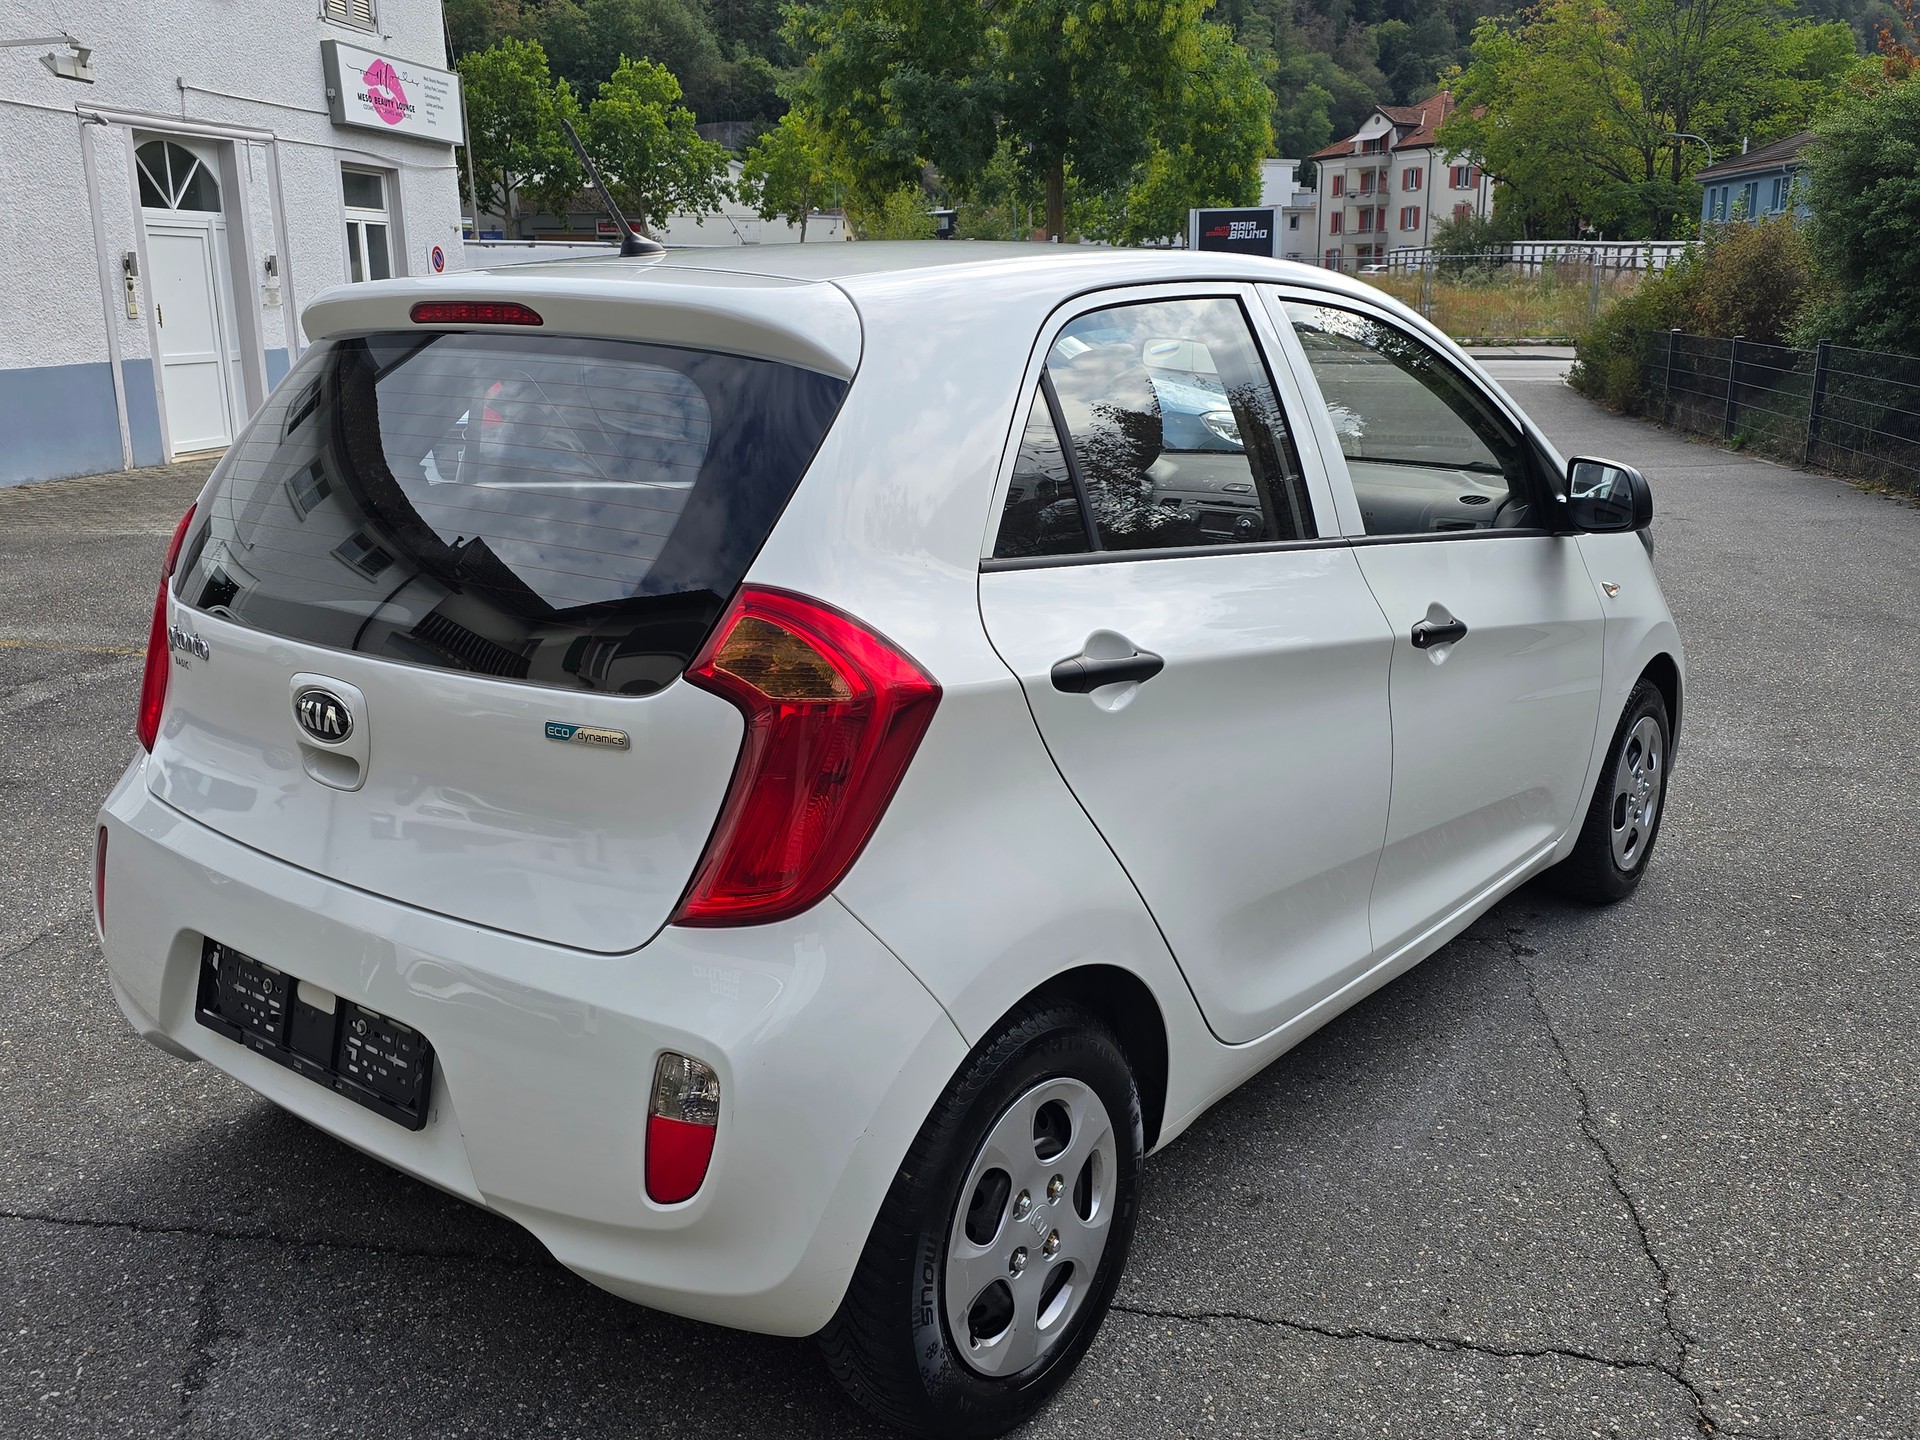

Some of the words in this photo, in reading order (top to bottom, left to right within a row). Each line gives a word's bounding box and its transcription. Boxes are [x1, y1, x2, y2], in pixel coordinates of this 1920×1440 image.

[357, 92, 372, 103] MESO
[374, 96, 394, 108] BEAUTY
[396, 101, 416, 113] LOUNGE
[1228, 230, 1268, 239] BRUNO
[1229, 221, 1257, 230] ARIA
[300, 698, 342, 735] KIA
[547, 726, 569, 737] ECO
[577, 730, 625, 746] dynamics
